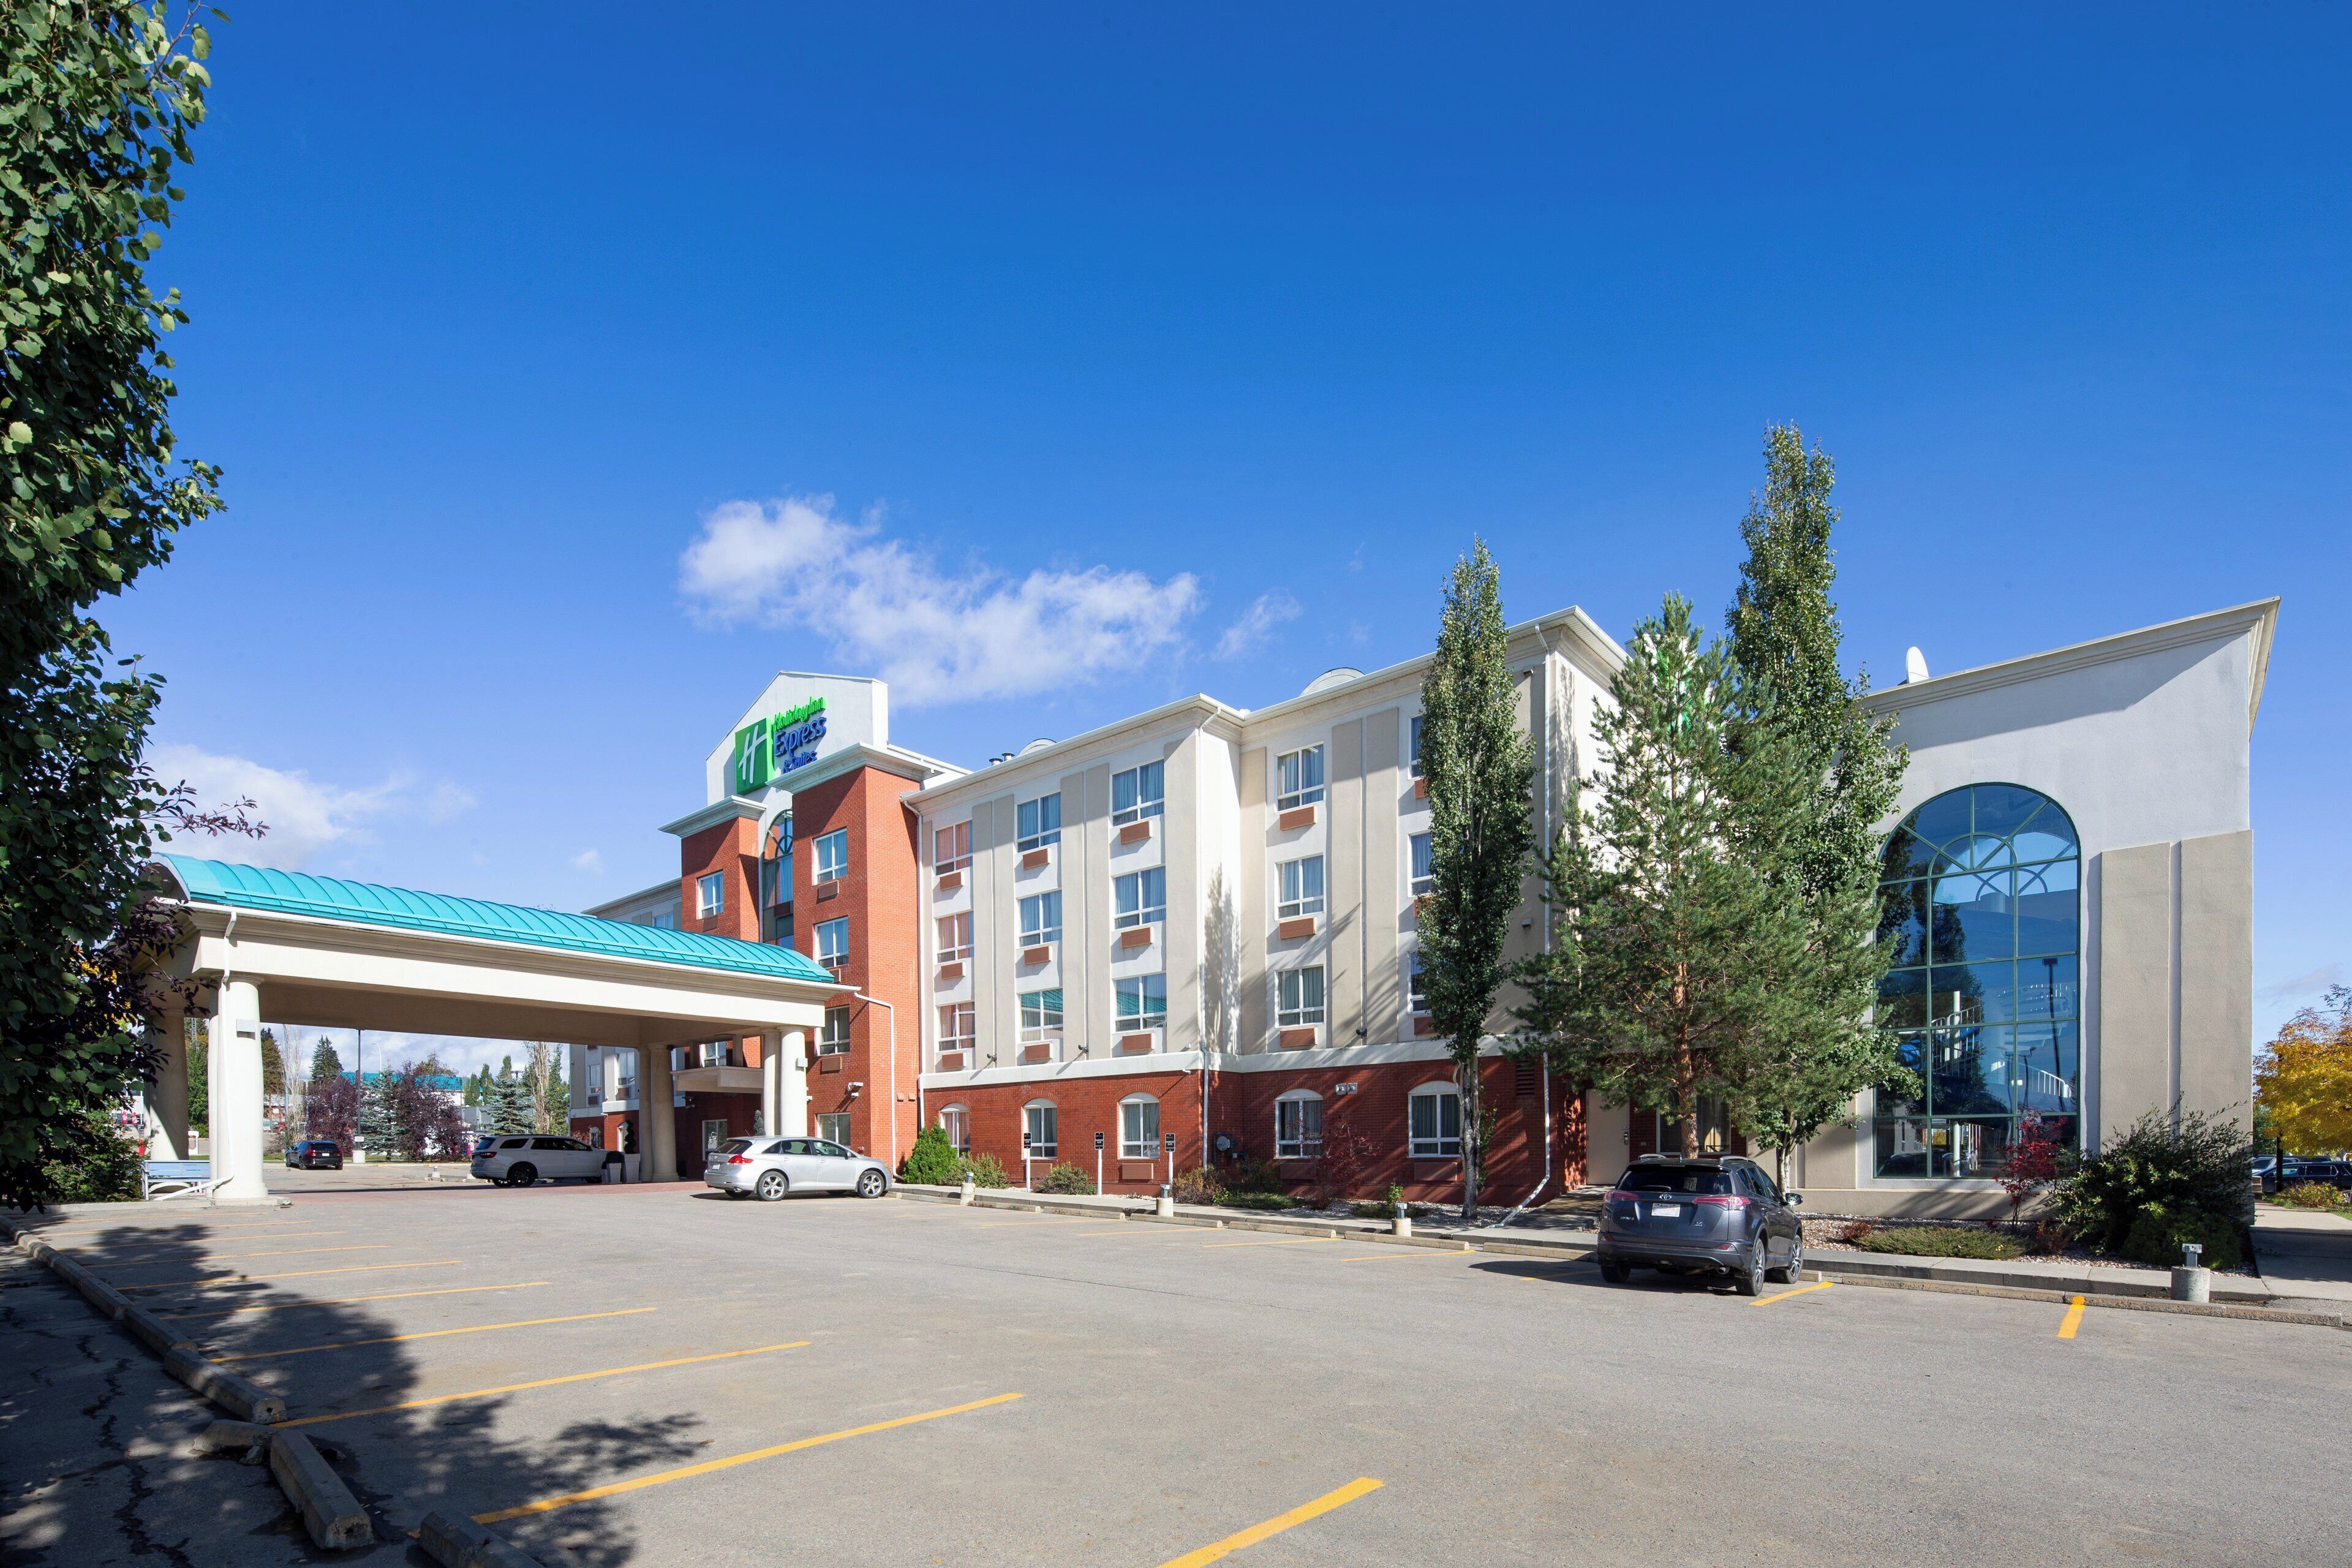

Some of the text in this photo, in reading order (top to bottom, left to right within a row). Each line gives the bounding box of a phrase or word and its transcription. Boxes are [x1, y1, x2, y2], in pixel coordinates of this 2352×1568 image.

[771, 696, 824, 732] Holiday Inn
[773, 716, 827, 758] Express
